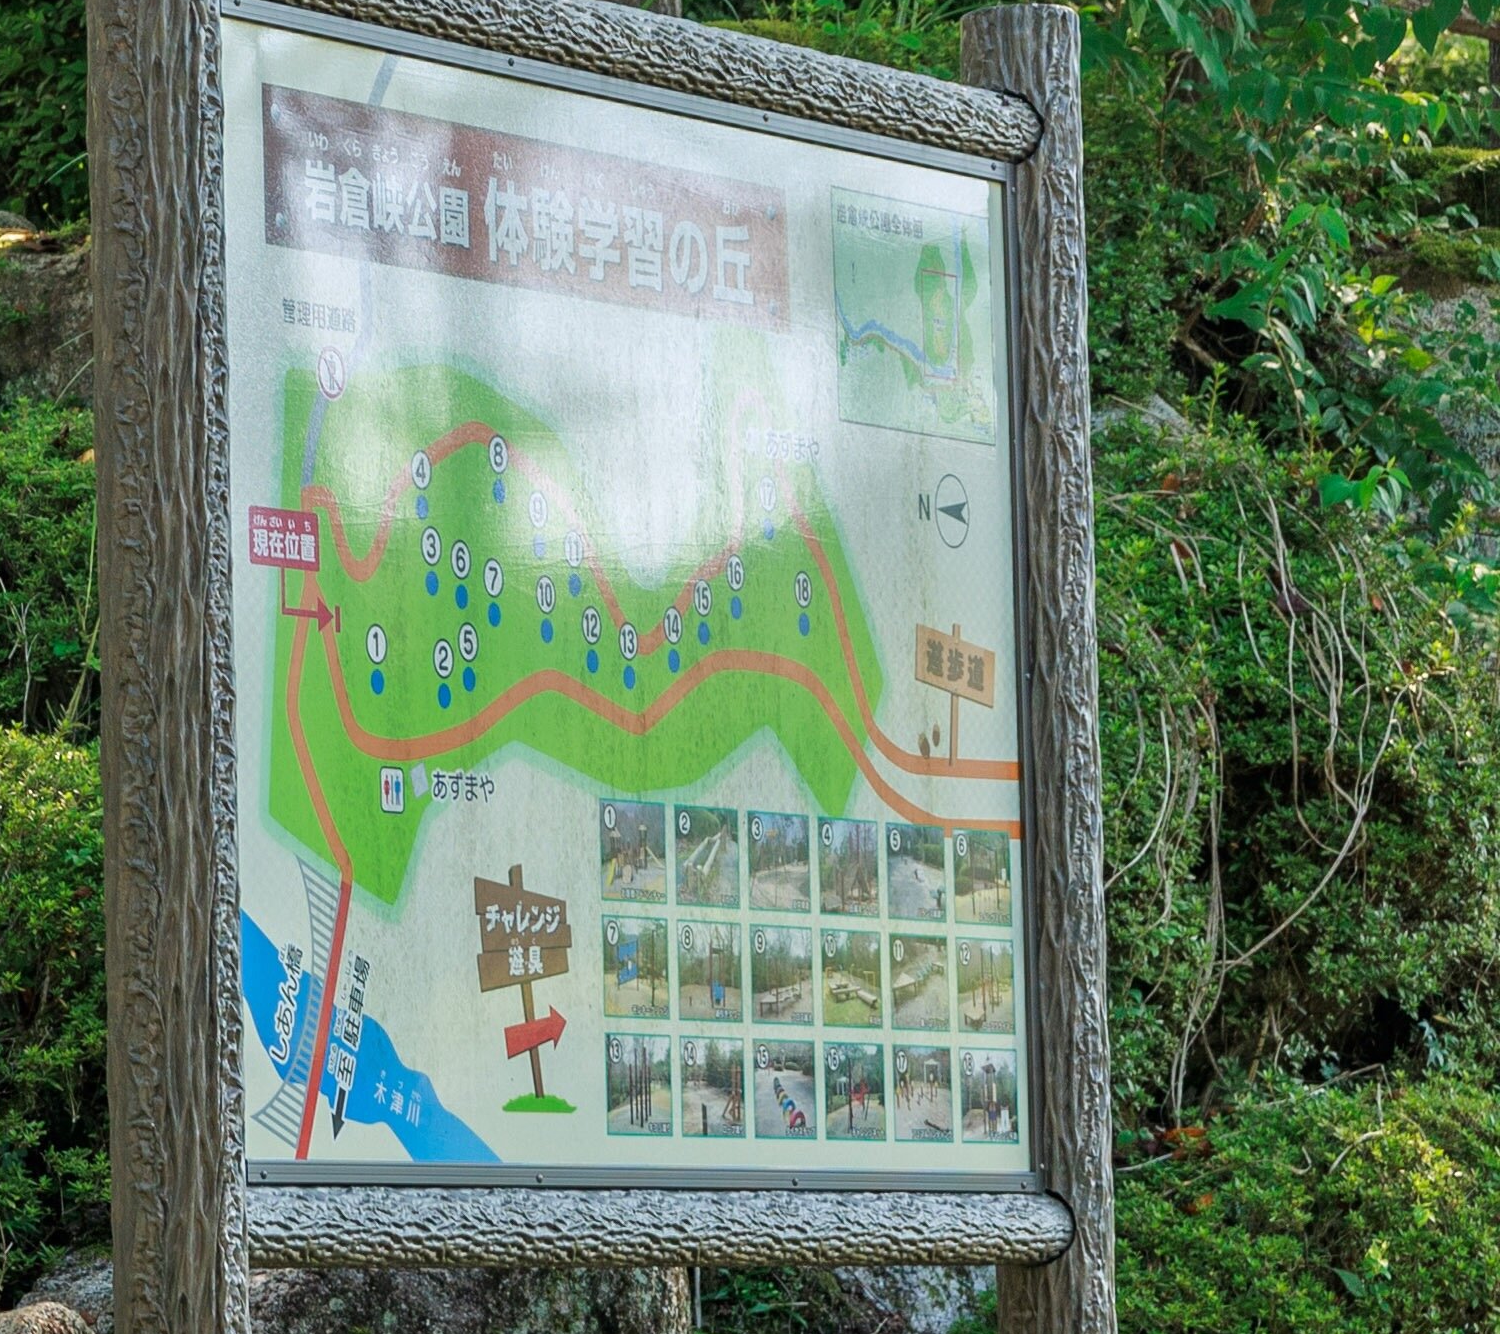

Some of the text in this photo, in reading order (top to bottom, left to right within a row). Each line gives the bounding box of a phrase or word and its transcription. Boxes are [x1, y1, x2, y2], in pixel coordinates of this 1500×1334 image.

[309, 131, 329, 151] いわ
[342, 138, 362, 157] くら
[372, 145, 399, 164] きょう
[442, 158, 461, 178] えん
[304, 159, 470, 249] 岩倉峡公園
[484, 176, 755, 305] 体験学習の丘
[283, 296, 356, 333] 管理用道路
[918, 494, 931, 521] N
[253, 528, 316, 562] 現在位置
[432, 771, 495, 803] あずまや
[485, 900, 560, 934] チャレンジ
[271, 944, 303, 1061] しあん橋
[343, 955, 370, 1049] 駐車場
[373, 1081, 421, 1128] 木津川
